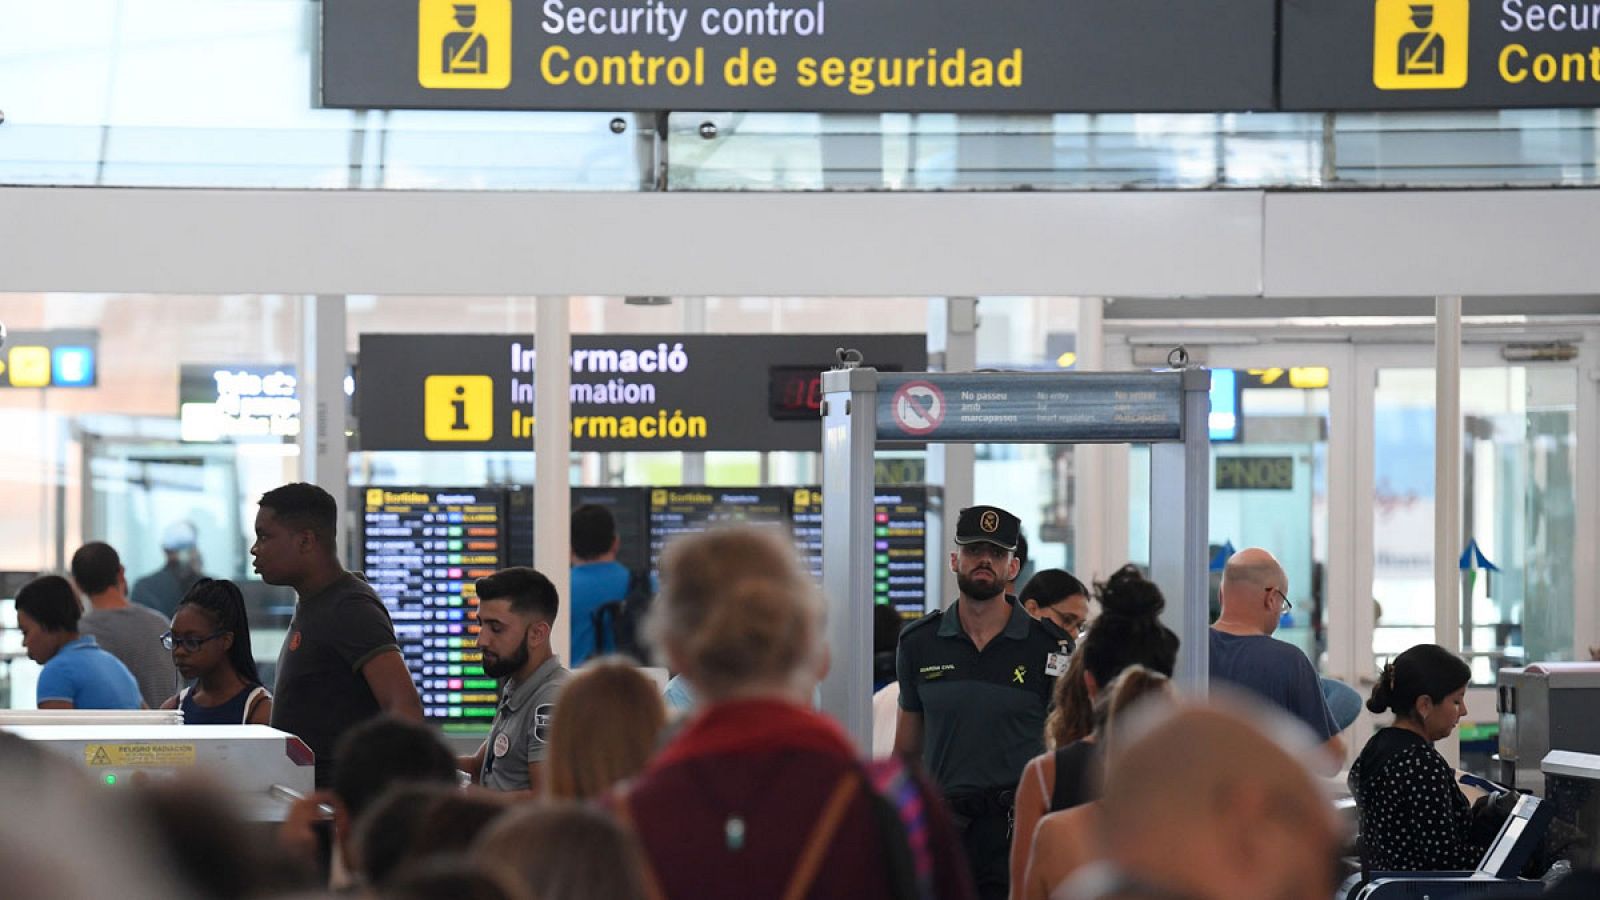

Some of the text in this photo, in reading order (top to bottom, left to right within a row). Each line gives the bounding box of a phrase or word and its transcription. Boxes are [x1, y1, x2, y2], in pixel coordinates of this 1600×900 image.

[541, 0, 825, 41] Security control
[540, 45, 1023, 95] Control de seguridad
[511, 343, 688, 372] Inrmació
[511, 378, 656, 404] Inmation
[961, 391, 974, 400] No
[511, 409, 707, 438] Inrmación
